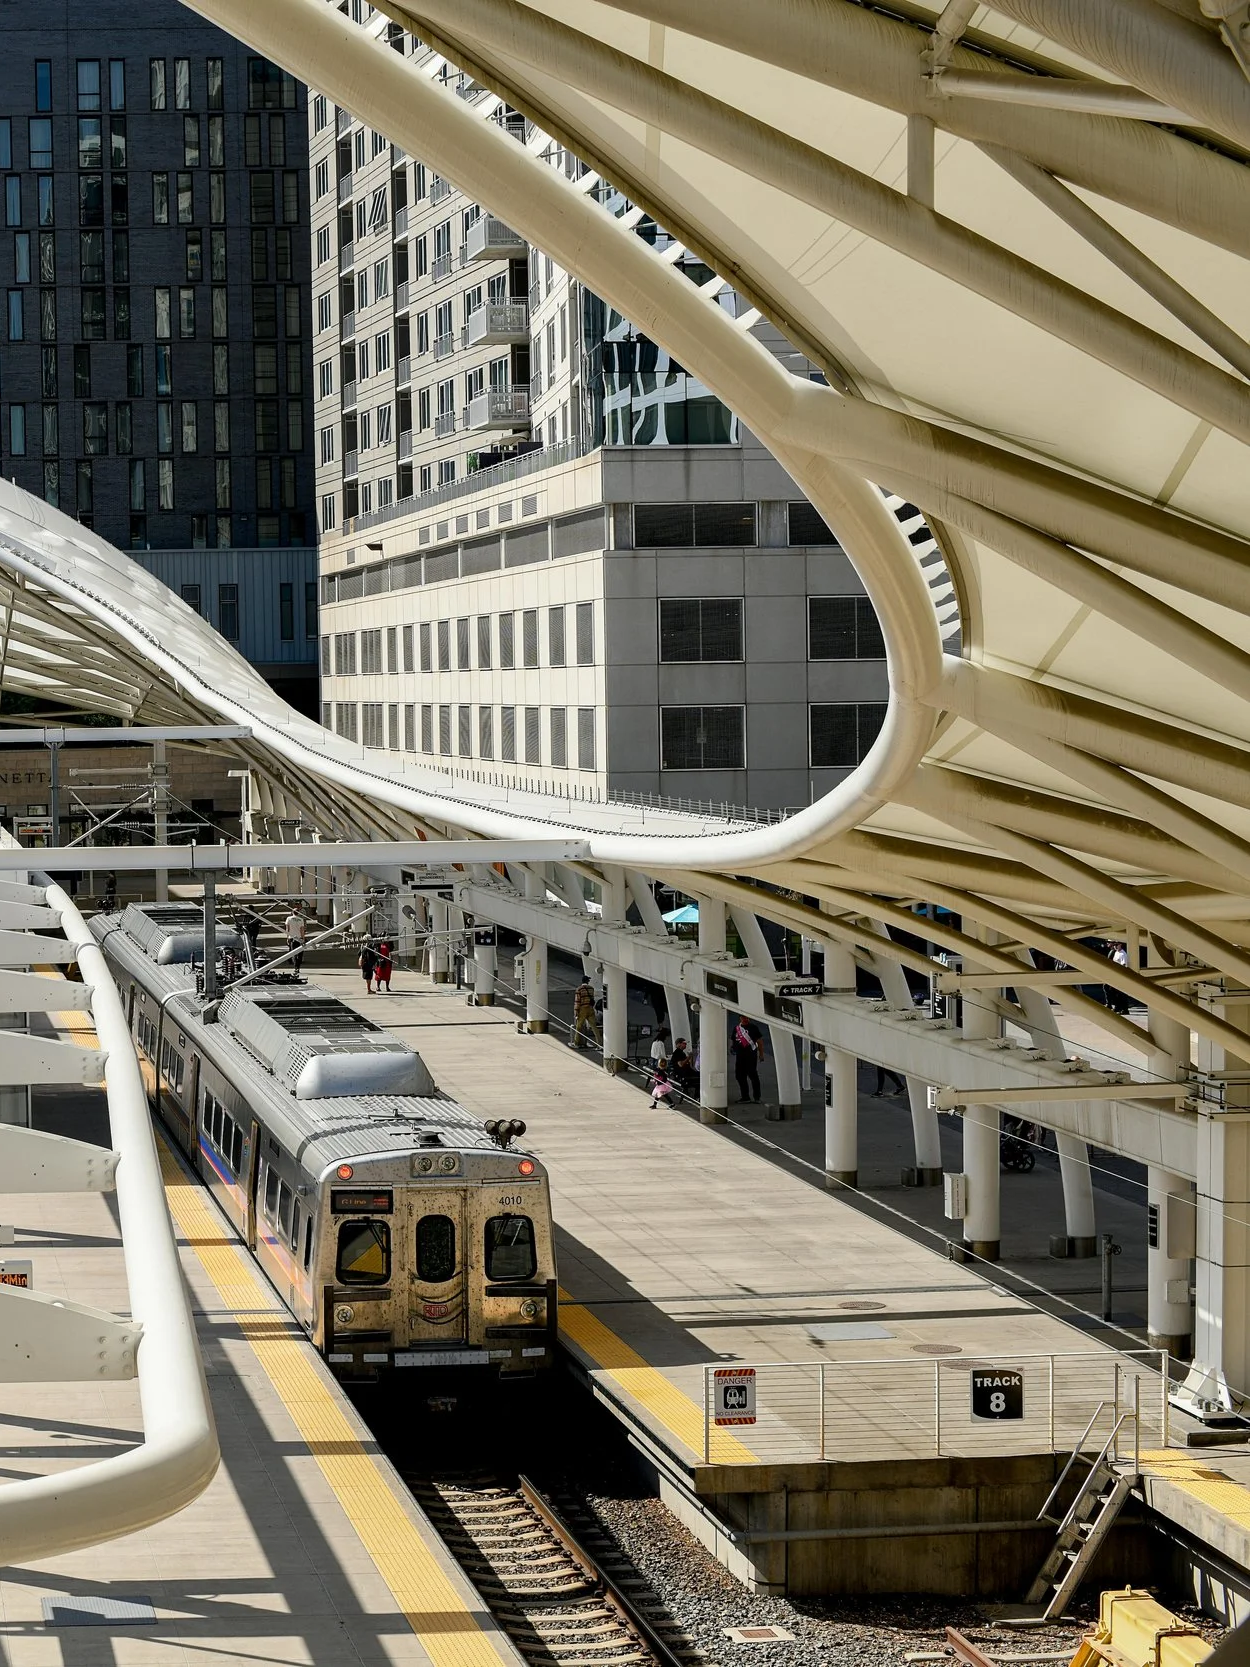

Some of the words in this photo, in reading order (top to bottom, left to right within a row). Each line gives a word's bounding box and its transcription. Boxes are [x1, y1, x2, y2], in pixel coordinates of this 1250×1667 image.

[499, 1196, 522, 1206] 4010
[423, 1305, 448, 1316] RTD
[717, 1377, 752, 1385] DANGER
[974, 1376, 1020, 1387] TRACK
[990, 1392, 1006, 1412] 8
